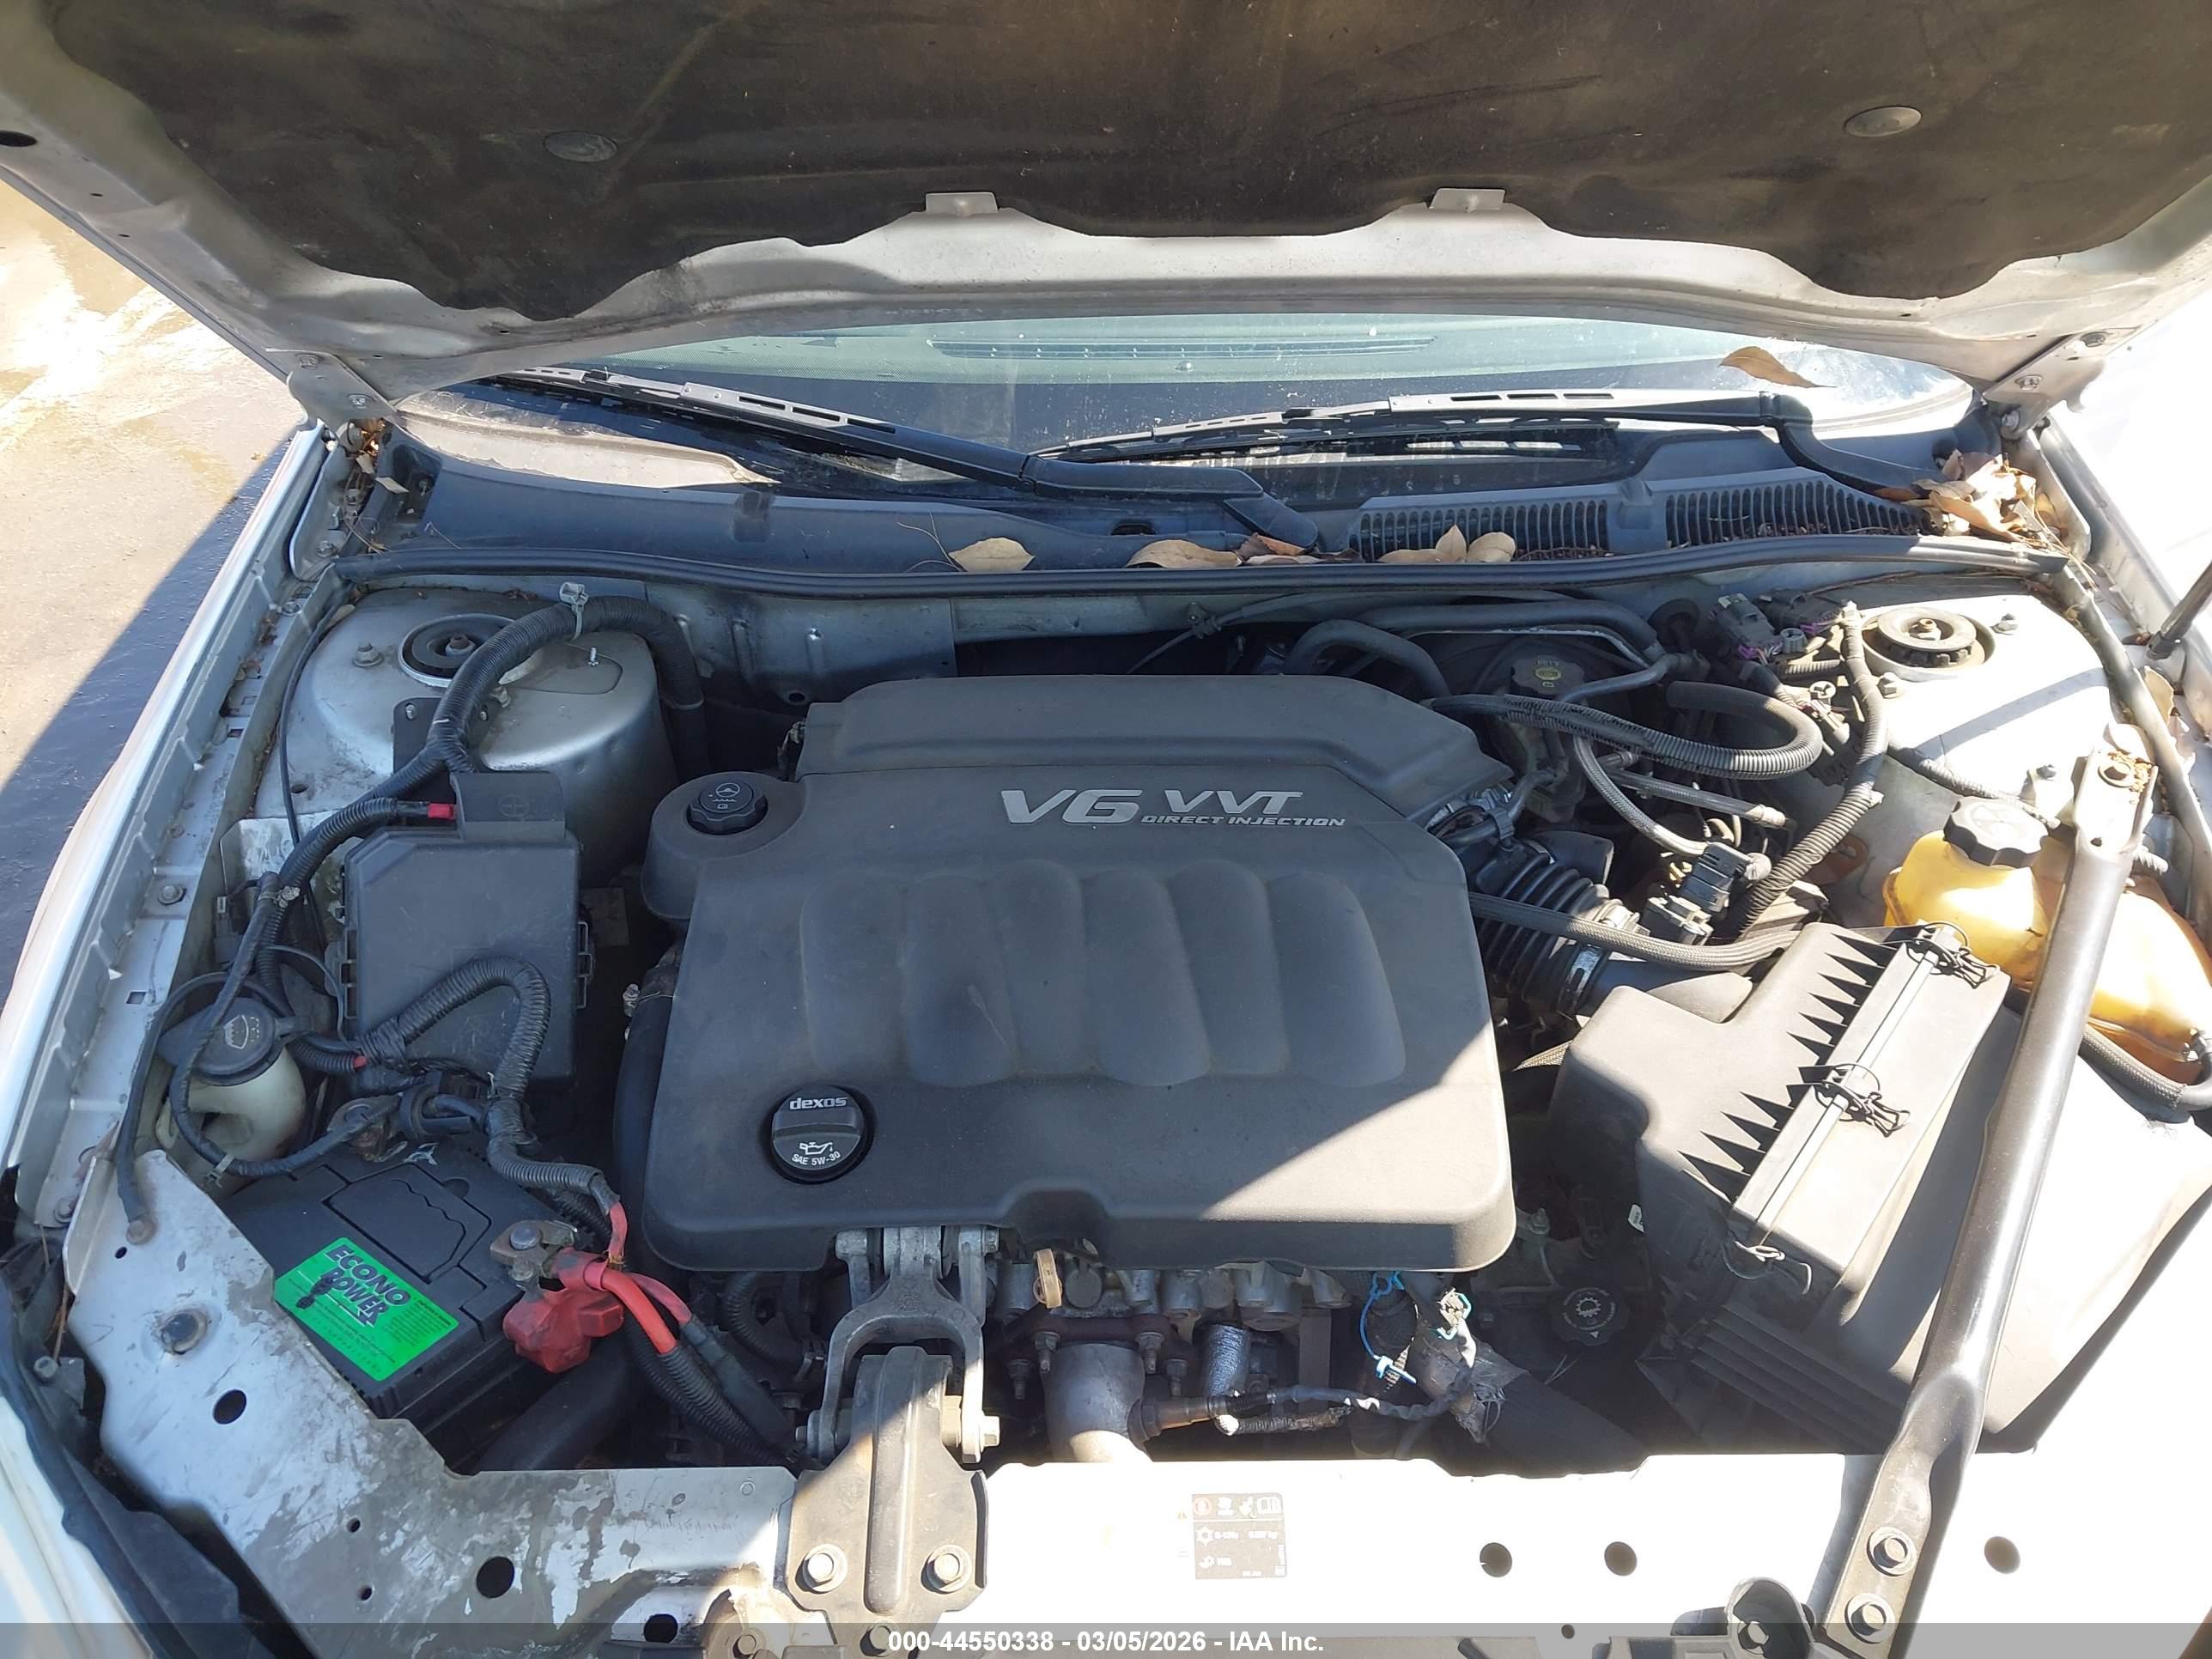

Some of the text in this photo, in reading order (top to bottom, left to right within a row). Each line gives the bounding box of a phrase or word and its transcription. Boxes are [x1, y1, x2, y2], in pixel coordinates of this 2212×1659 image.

[1000, 789, 1304, 824] V6 VVT
[1140, 816, 1346, 827] DIRECT INJECTION
[790, 1097, 848, 1109] dexos
[792, 1151, 841, 1165] SAE 5W-30
[324, 1243, 411, 1306] ECONO
[319, 1266, 389, 1328] POWER
